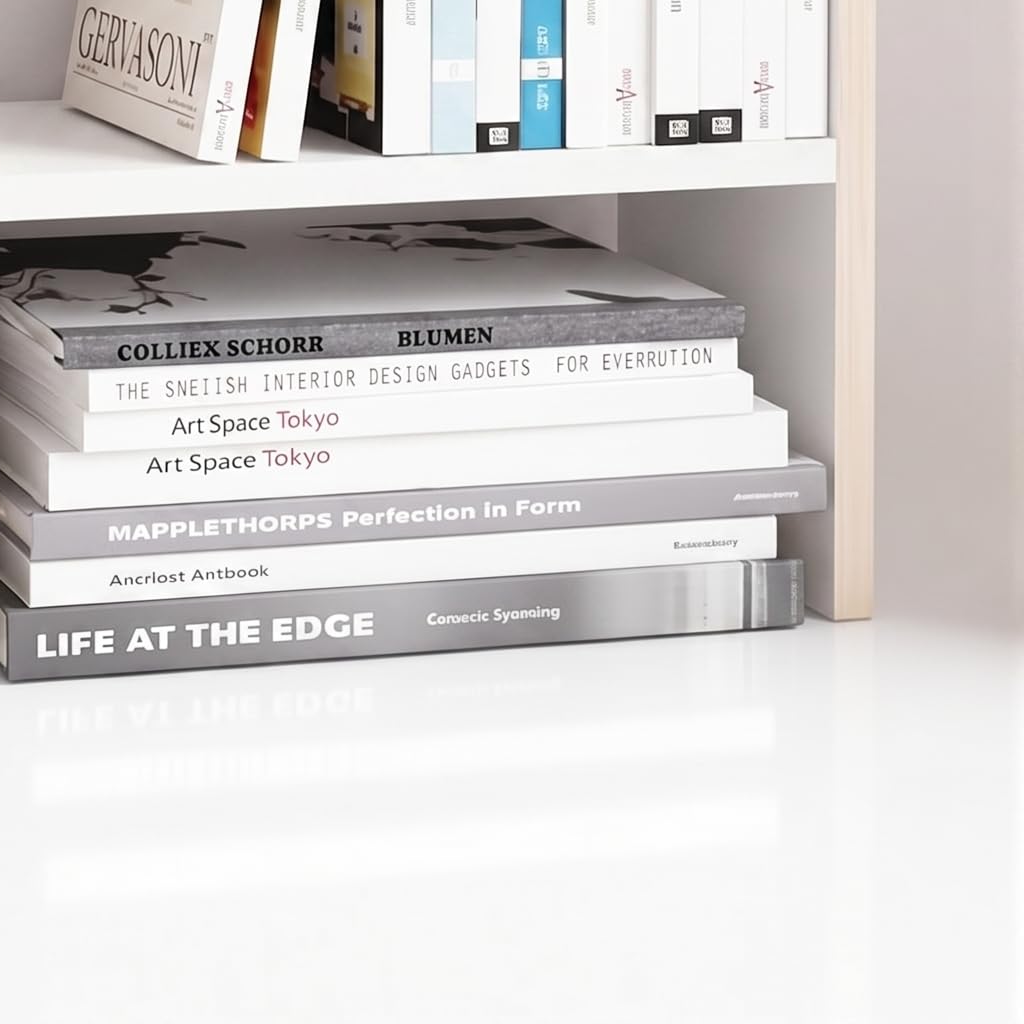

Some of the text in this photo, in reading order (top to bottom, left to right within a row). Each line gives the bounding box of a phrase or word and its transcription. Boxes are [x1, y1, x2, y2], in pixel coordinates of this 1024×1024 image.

[78, 6, 202, 97] GERVASONI
[117, 335, 324, 362] COLLIEX SCHORR
[397, 326, 494, 347] BLUMEN
[116, 382, 150, 400] THE
[264, 369, 356, 392] INTERIOR
[369, 363, 438, 386] DESIGN
[451, 358, 531, 380] GADGETS
[556, 355, 589, 374] FOR
[603, 347, 713, 371] EVERRUTION
[171, 408, 339, 437] Art Space Tokyo
[146, 448, 330, 475] Art Space Tokyo
[108, 496, 581, 542] MAPPLETHORPS Perfection in Form
[191, 565, 269, 581] Antbook
[36, 612, 374, 659] LIFE AT THE EDGE
